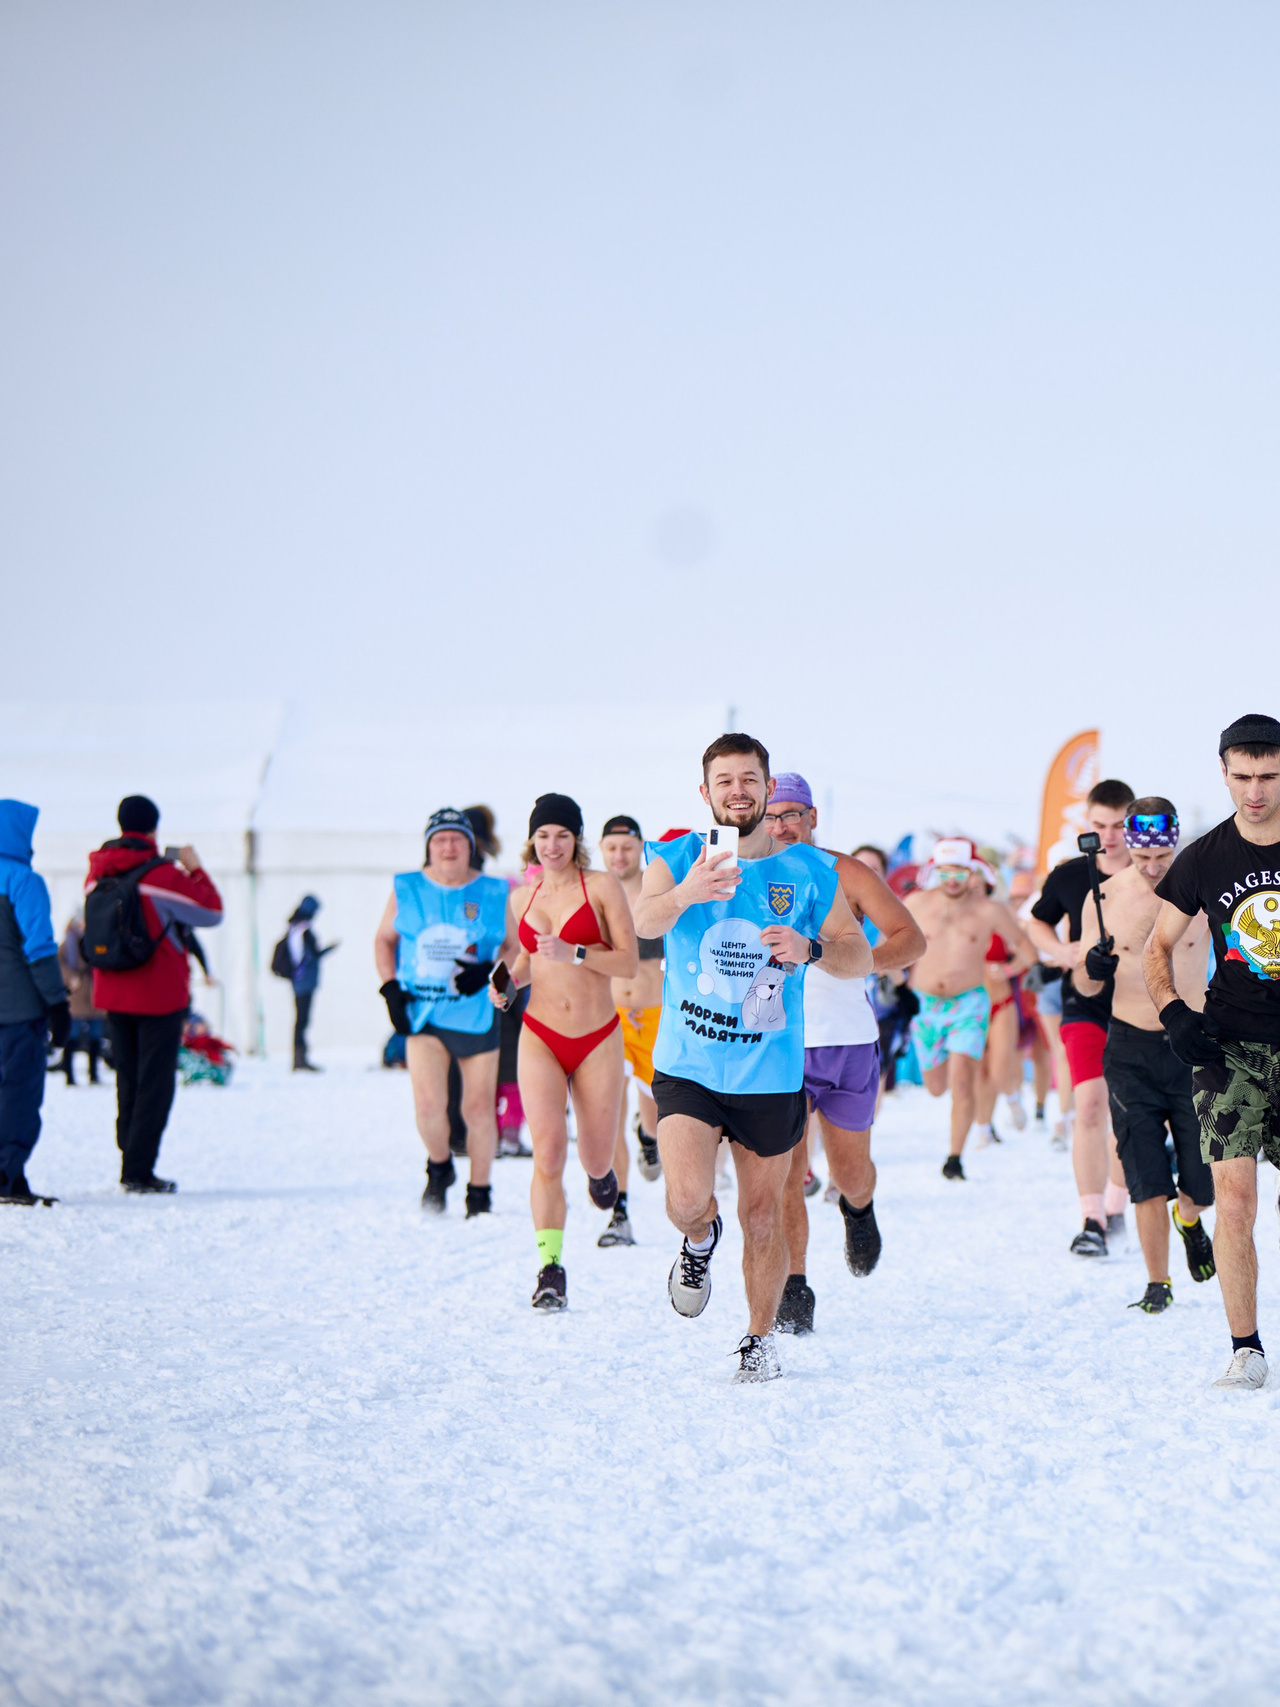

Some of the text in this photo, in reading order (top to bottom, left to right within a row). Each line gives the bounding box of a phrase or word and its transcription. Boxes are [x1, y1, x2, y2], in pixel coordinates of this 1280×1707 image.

[721, 941, 747, 950] ЦЕНТР
[680, 999, 738, 1029] МОРЖИ
[684, 1016, 763, 1044] ОЛЬЯТТИ
